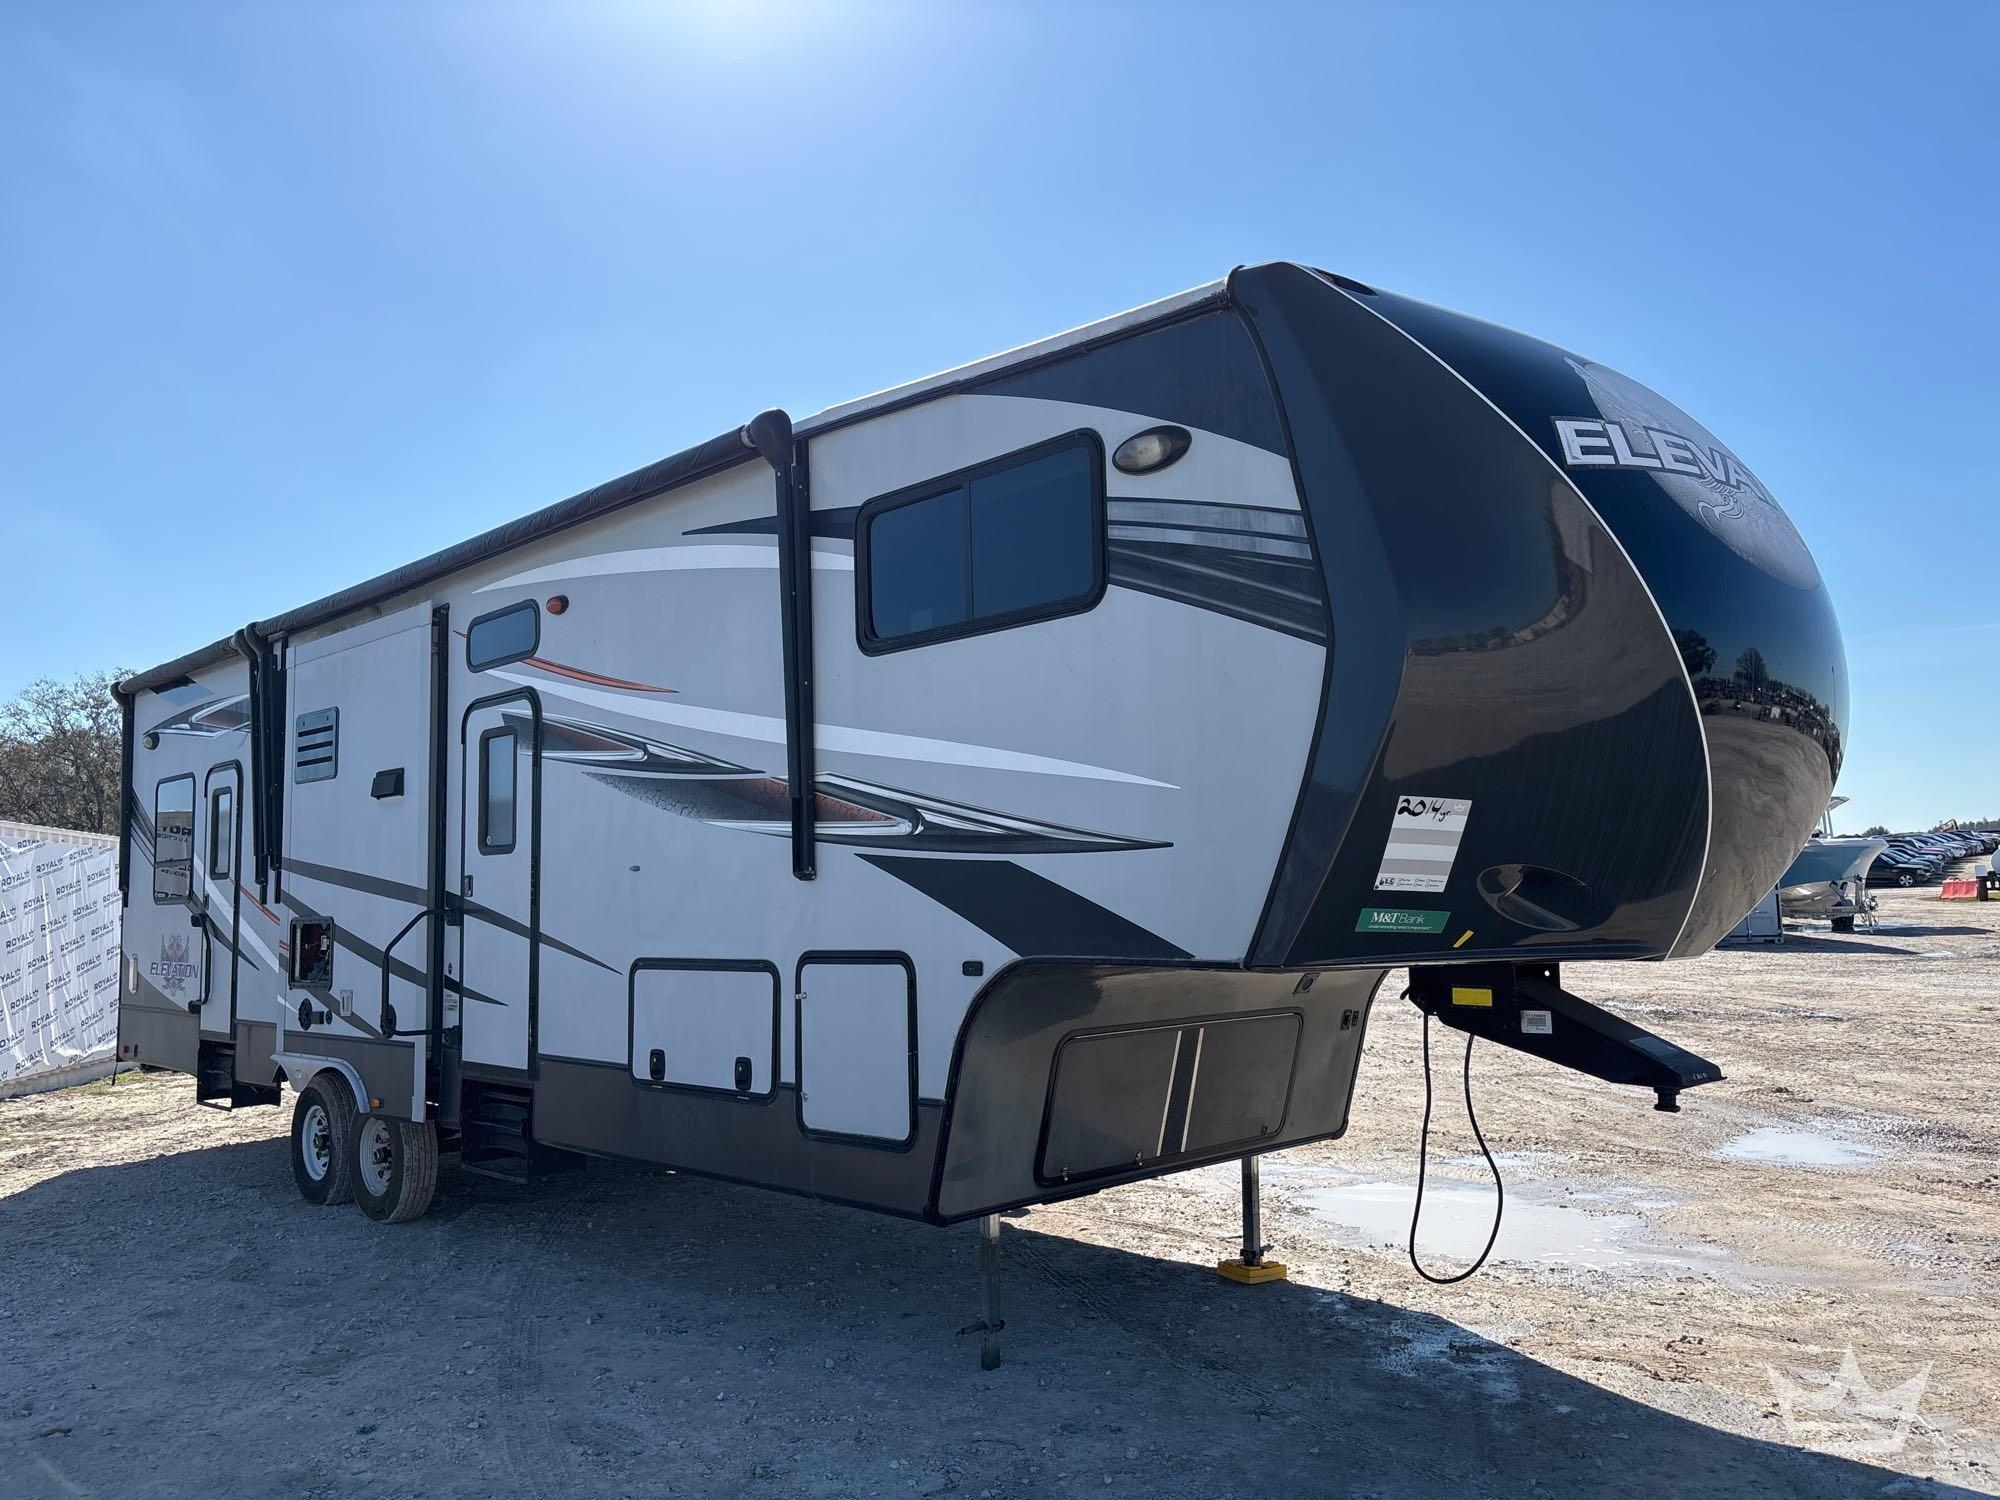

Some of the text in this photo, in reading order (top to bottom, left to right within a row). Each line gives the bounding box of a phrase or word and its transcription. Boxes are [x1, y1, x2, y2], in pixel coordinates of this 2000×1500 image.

[1551, 417, 1768, 504] ELEVA
[36, 859, 58, 873] ROYAL
[1, 872, 25, 887] ROYAL
[87, 868, 106, 882] ROYAL
[56, 881, 76, 896] ROYAL
[23, 895, 45, 911] ROYAL
[73, 903, 93, 917] ROYAL
[1370, 911, 1425, 925] M&T Bank
[91, 923, 110, 937] ROYAL
[5, 933, 29, 949] ROYAL
[60, 937, 80, 953] ROYAL
[106, 944, 121, 957] ROYA
[27, 954, 49, 970] ROYAL
[76, 957, 96, 973] ROYAL
[150, 960, 200, 979] ELEVATION
[46, 974, 66, 991] ROYAL
[94, 975, 113, 991] ROYAL
[10, 993, 33, 1011] ROYAL
[64, 992, 84, 1010] ROYAL
[31, 1012, 53, 1030] ROYAL
[81, 1011, 99, 1028] ROYAL
[0, 1032, 19, 1049] OYAL
[15, 1051, 39, 1071] ROYAL
